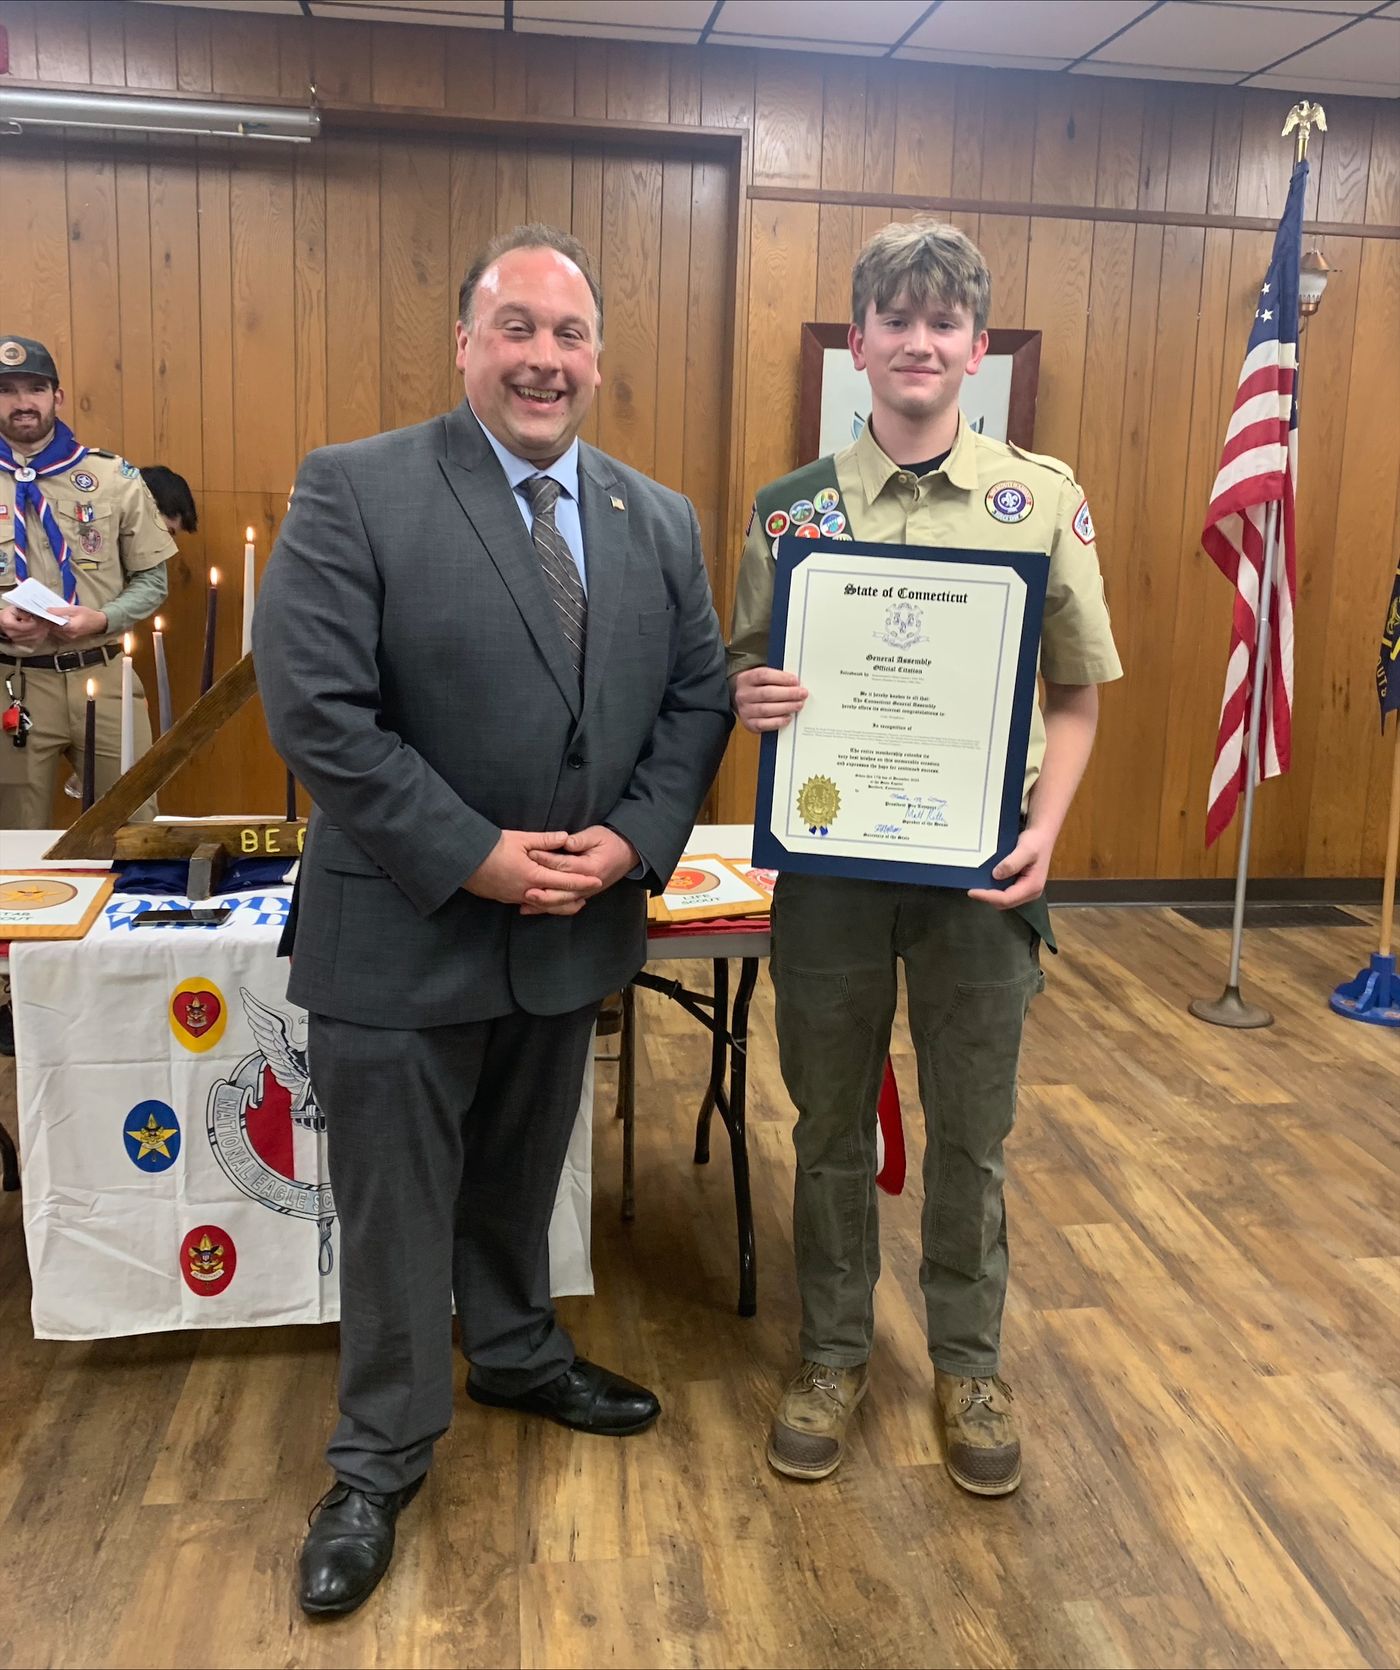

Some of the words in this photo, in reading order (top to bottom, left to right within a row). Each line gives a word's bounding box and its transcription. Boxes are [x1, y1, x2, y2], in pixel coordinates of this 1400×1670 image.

[843, 582, 879, 597] State
[882, 586, 894, 598] of
[897, 587, 968, 604] Connecticut
[866, 654, 894, 662] General
[897, 656, 932, 666] Assembly
[240, 828, 281, 853] BE
[217, 1098, 256, 1180] NATIONAL
[250, 1173, 308, 1210] EAGLE
